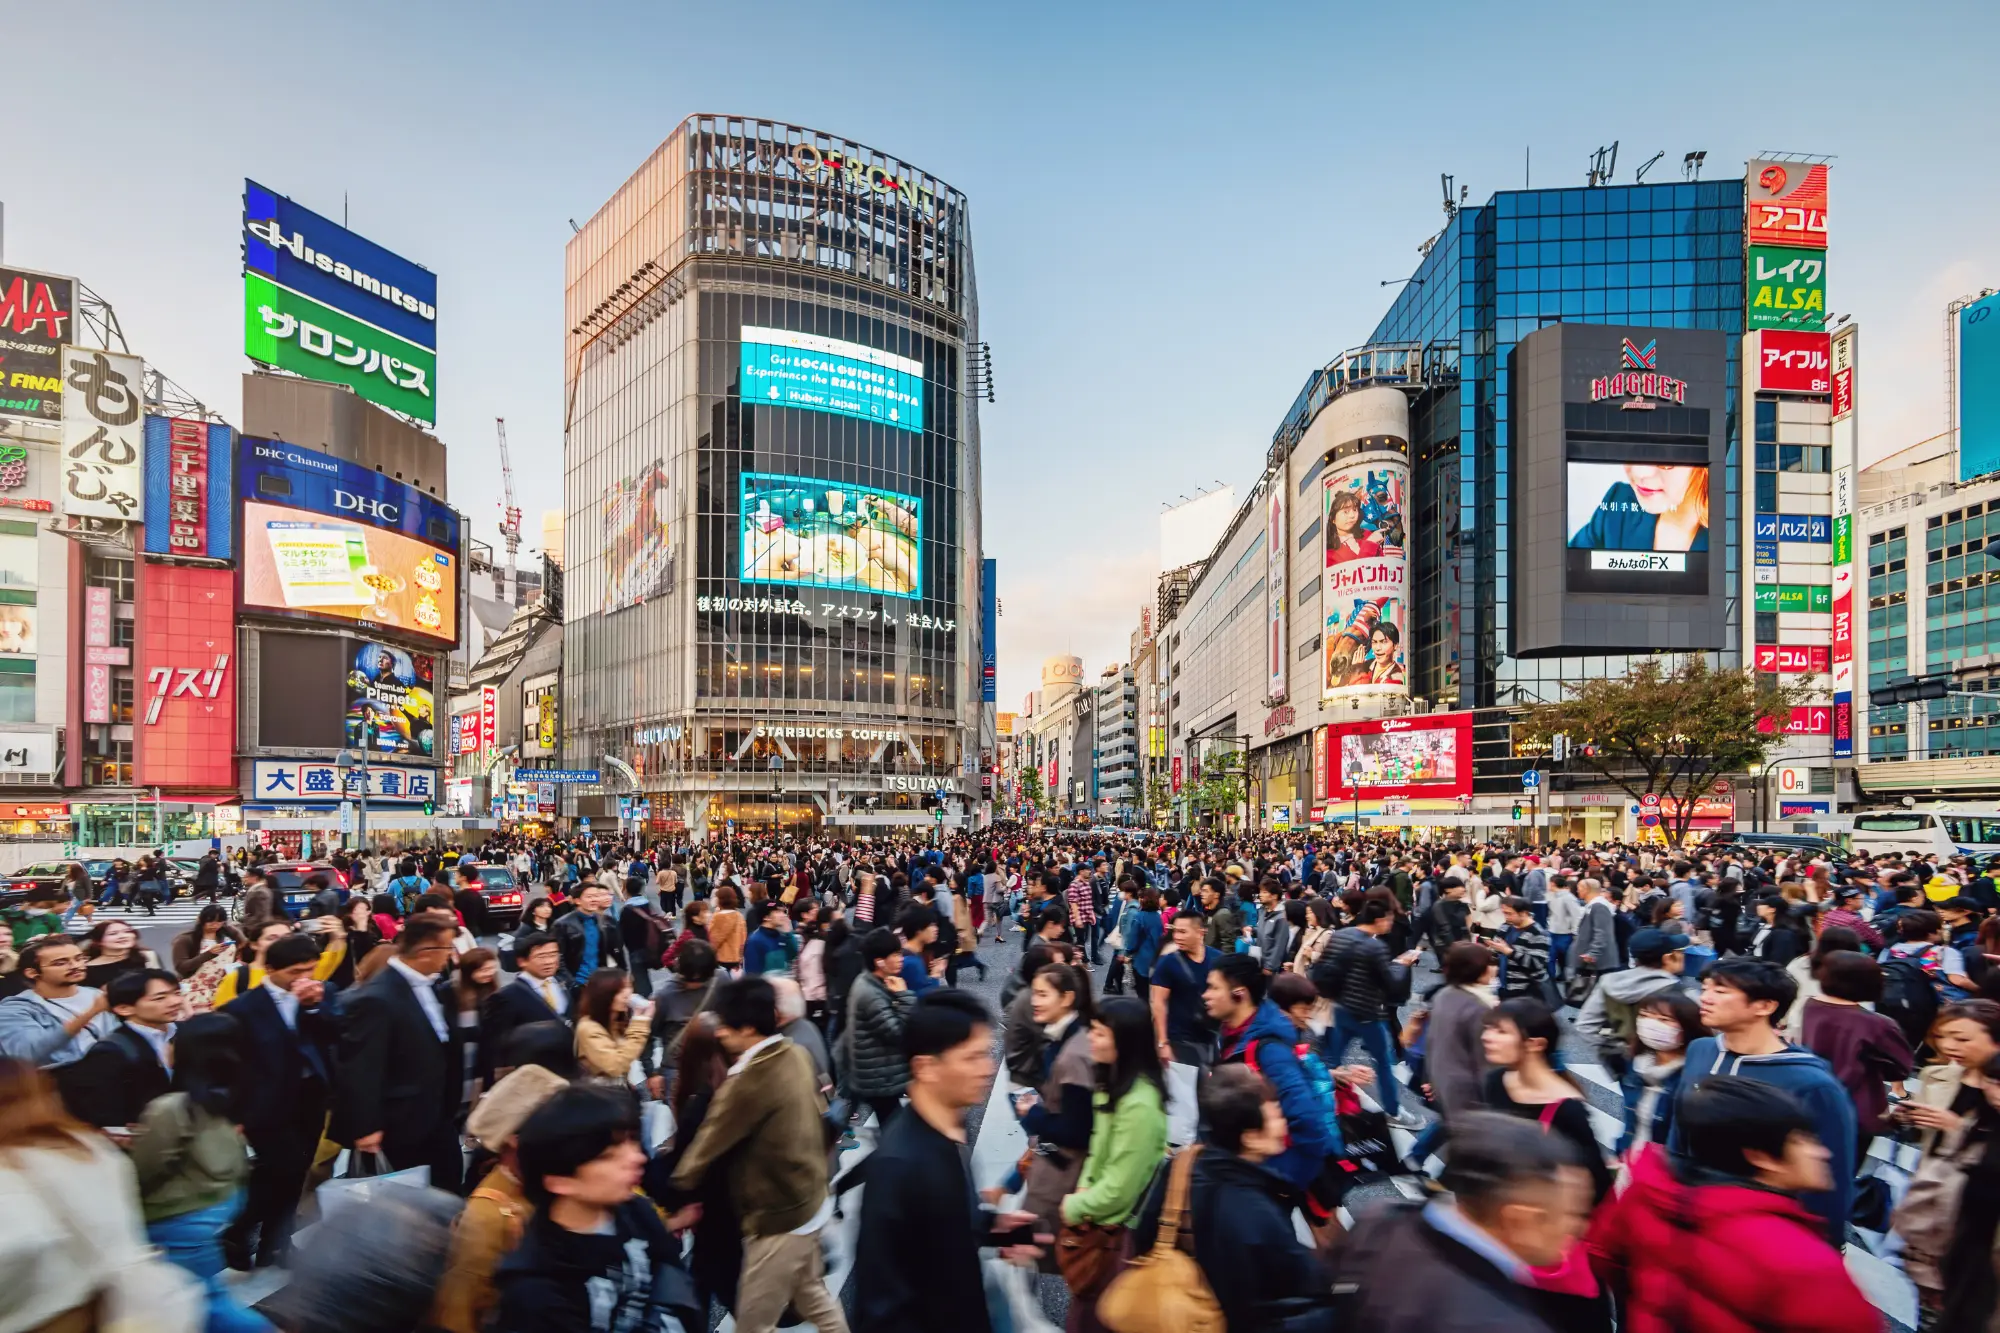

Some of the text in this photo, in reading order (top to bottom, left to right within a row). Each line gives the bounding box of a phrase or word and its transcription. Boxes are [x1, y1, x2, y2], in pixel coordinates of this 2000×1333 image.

[792, 142, 935, 214] QFRONT
[1761, 205, 1829, 233] アコム
[247, 219, 436, 321] Hisamitsu
[1756, 256, 1822, 284] レイク
[1753, 285, 1823, 311] ALSA
[257, 303, 431, 398] サロンパス
[1763, 348, 1829, 370] アイフル
[770, 353, 791, 366] Get
[793, 357, 836, 374] LOCAL
[837, 365, 886, 384] GUIDES
[746, 364, 919, 407] Experience the REAL SHIBUYA
[1591, 372, 1688, 405] MAGNET
[1811, 379, 1828, 391] 8F
[1837, 379, 1849, 414] アイフル
[829, 397, 861, 411] Japan
[67, 352, 138, 517] もんじゃ
[254, 445, 338, 474] DHC Channel
[170, 421, 200, 548] 三千里薬品
[333, 488, 399, 523] DHC
[1756, 521, 1825, 537] レオパレス21
[1607, 555, 1669, 570] みんなのFX
[1330, 563, 1404, 590] ジャパンカップ
[1755, 591, 1803, 601] レイク ALSA
[1816, 594, 1828, 604] 5F
[357, 620, 377, 629] DHC
[1836, 611, 1849, 642] アコム
[984, 653, 995, 692] SEIBU
[1760, 651, 1808, 667] アコム
[144, 654, 230, 726] クスリ
[366, 686, 418, 707] Planets
[374, 680, 406, 693] teamLab
[757, 726, 901, 741] STARBUCKS COFFEE
[1381, 719, 1411, 732] Glico
[1785, 721, 1803, 731] 入口
[1837, 702, 1849, 741] PROMISE
[265, 767, 430, 796] 大盛堂書店
[886, 776, 955, 792] TSUTAYA
[1783, 806, 1813, 815] PROMISE
